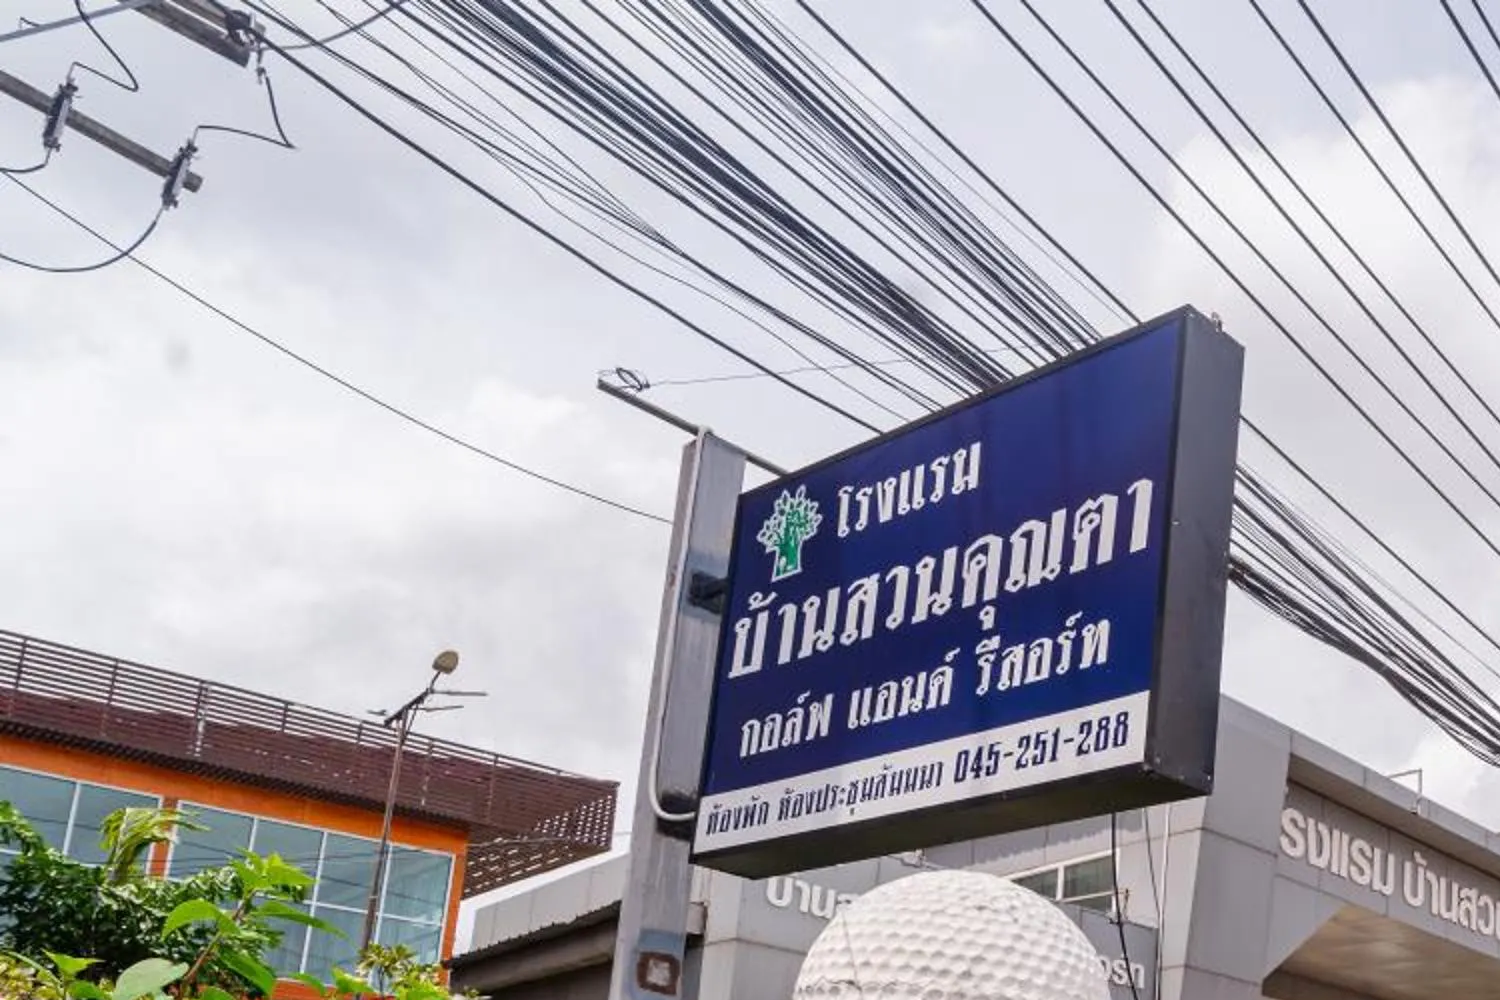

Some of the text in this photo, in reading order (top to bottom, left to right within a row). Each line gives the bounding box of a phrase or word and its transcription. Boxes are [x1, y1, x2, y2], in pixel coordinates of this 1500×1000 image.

[836, 441, 983, 538] โรงแรม
[727, 478, 1154, 679] บ้านสวนคุณตา
[739, 611, 1111, 758] กอล์ฟ แอนด์ รีสอร์ท
[706, 796, 770, 836] ห้องพัก
[954, 711, 1130, 783] 045-251-288
[1279, 807, 1395, 896] รงแรม
